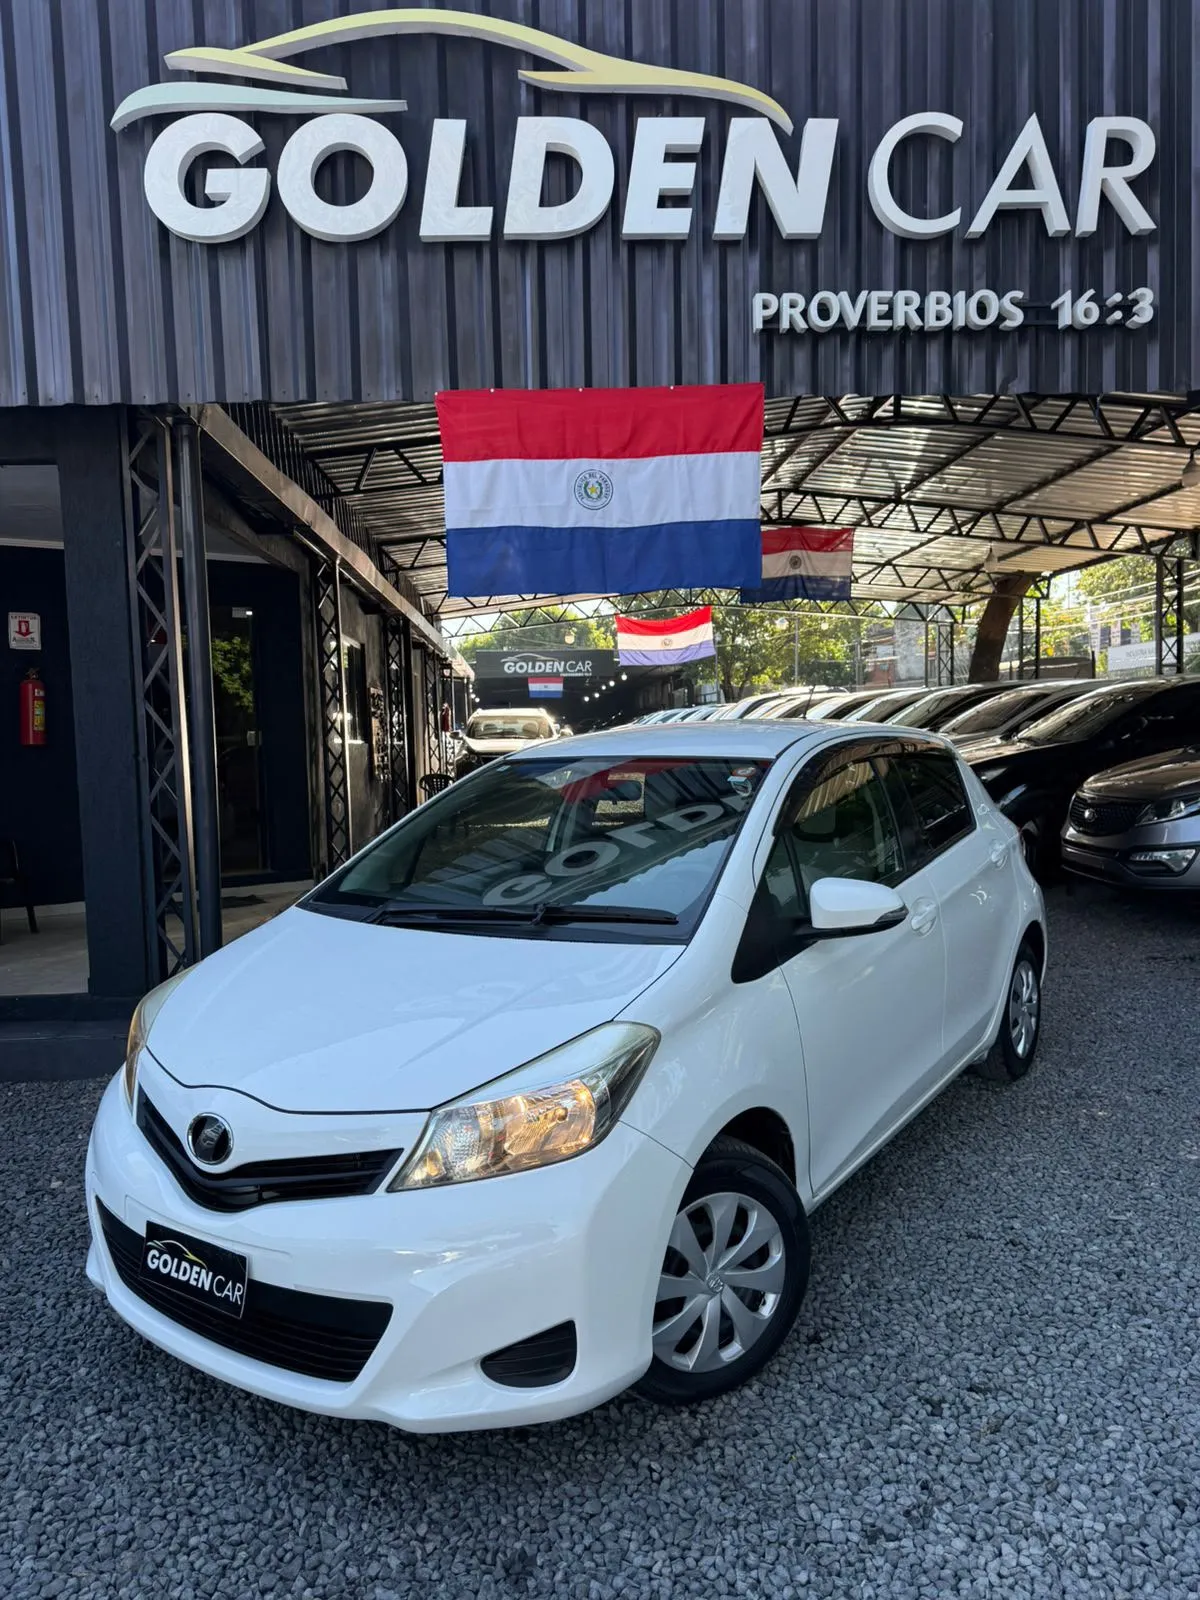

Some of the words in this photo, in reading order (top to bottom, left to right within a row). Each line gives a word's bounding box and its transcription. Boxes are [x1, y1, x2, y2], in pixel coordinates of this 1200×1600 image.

[144, 112, 838, 243] GOLDEN
[868, 111, 1157, 239] CAR
[753, 289, 1025, 333] PROVERBIOS
[1051, 286, 1154, 329] 16:3
[503, 660, 564, 674] GOLDEN
[565, 660, 593, 673] CAR
[147, 1249, 213, 1291] GOLDEN
[213, 1275, 243, 1305] CAR
